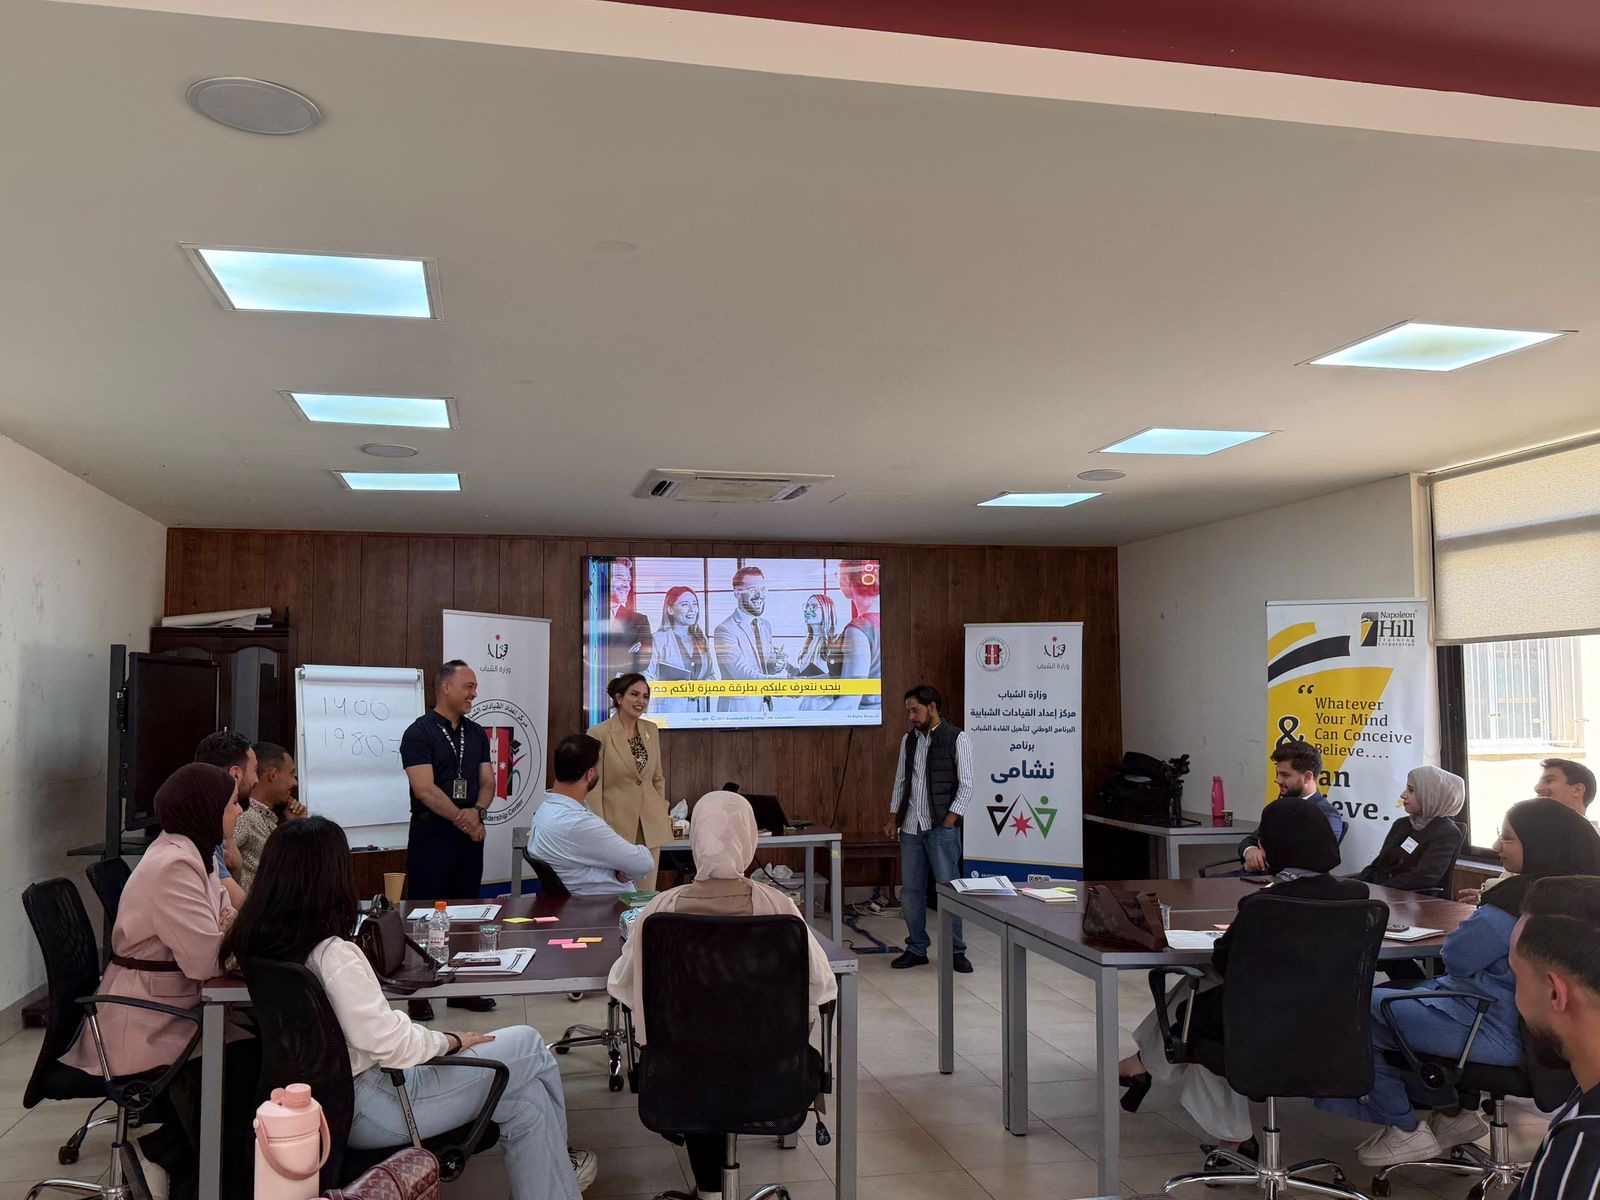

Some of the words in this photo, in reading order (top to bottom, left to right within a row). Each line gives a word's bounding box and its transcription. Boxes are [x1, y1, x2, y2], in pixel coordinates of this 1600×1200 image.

[1380, 611, 1415, 619] Napoleon
[1379, 620, 1415, 637] Hill
[670, 682, 695, 695] لأنكم
[697, 683, 726, 695] مميزة
[761, 682, 788, 694] عليكم
[790, 682, 817, 694] نتعرف
[820, 683, 841, 693] بنحب
[997, 689, 1026, 700] الشباب
[1028, 690, 1048, 700] وزارة
[323, 697, 390, 721] 1400
[1315, 698, 1384, 711] Whatever
[970, 708, 1001, 718] الشبابية
[1002, 708, 1036, 719] القيادات
[1038, 708, 1057, 719] إعداد
[1059, 708, 1077, 719] مركز
[1315, 713, 1347, 725] Your
[1350, 713, 1388, 726] Mind
[971, 724, 992, 732] الشباب
[1011, 724, 1030, 733] لتأهيل
[1031, 726, 1053, 735] الوطني
[1053, 726, 1076, 734] البرنامج
[1314, 728, 1338, 740] Can
[1343, 729, 1412, 744] Conceive
[1009, 741, 1035, 752] برنامج
[991, 760, 1055, 784] نشامى
[1318, 770, 1351, 788] an
